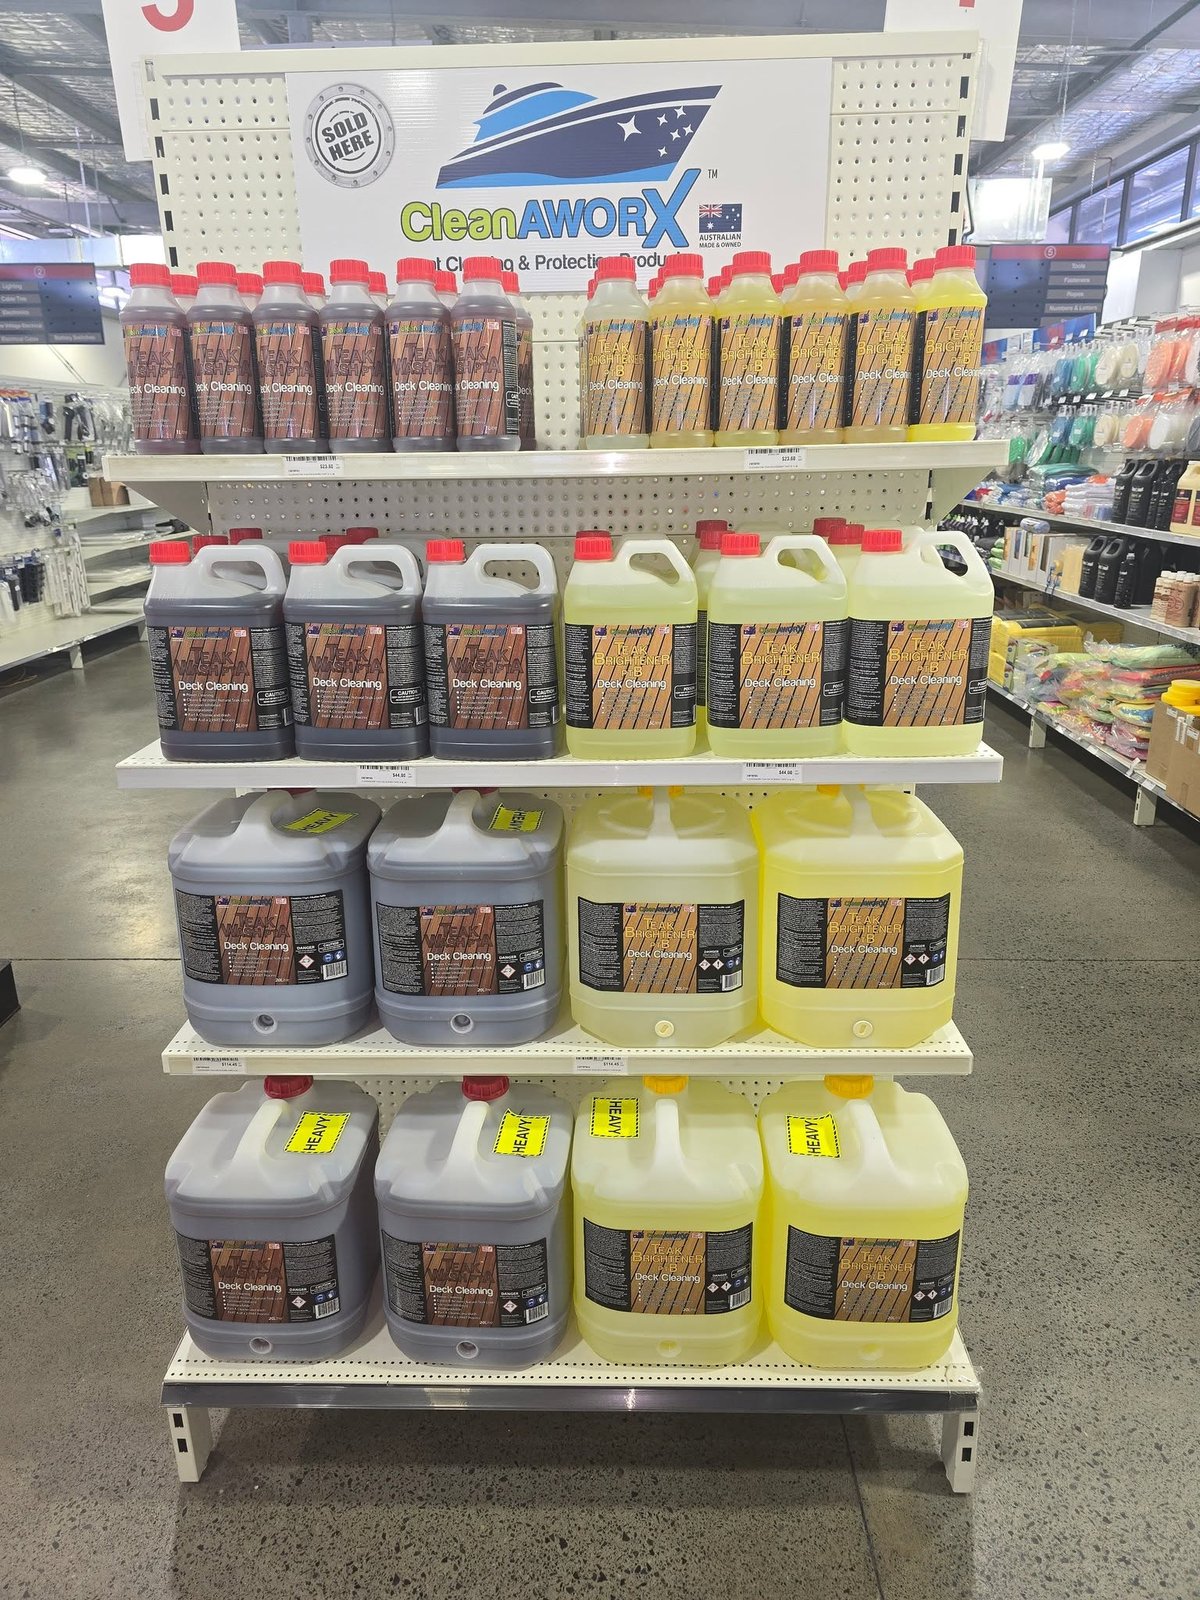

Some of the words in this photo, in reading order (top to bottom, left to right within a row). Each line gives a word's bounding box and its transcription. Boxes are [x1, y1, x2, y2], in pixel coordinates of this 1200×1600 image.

[321, 112, 369, 143] SOLD
[328, 129, 374, 161] HERE
[400, 168, 702, 248] CleanAWORX
[699, 232, 742, 241] AUSTRALIAN
[518, 254, 530, 270] &
[535, 253, 604, 270] Protecti
[1049, 304, 1073, 312] Numbers
[129, 346, 172, 366] TEAK
[198, 343, 240, 363] TEAK
[260, 344, 298, 364] TEAK
[332, 344, 374, 364] TEAK
[404, 342, 448, 362] TEAK
[791, 373, 815, 384] Deck
[858, 369, 881, 381] Deck
[926, 367, 951, 379] Deck
[394, 381, 416, 392] Deck
[461, 380, 499, 391] Cleaning
[607, 379, 643, 392] Cleaning
[671, 374, 708, 387] Cleaning
[722, 375, 742, 386] Deck
[128, 384, 142, 395] eck
[143, 383, 186, 397] Cleaning
[210, 381, 252, 395] Cleaning
[260, 385, 271, 394] eck
[271, 382, 312, 395] Cleaning
[345, 382, 384, 395] Cleaning
[614, 641, 647, 655] TEAK
[764, 640, 797, 654] TEAK
[911, 637, 946, 651] TEAK
[190, 646, 234, 665] TEAK
[325, 643, 368, 662] TEAK
[466, 643, 508, 661] TEAK
[742, 651, 820, 665] BRIGHTENER
[888, 648, 967, 662] BRIGHTENER
[594, 652, 670, 667] BRIGHTENER
[633, 666, 643, 677] B
[782, 664, 792, 676] B
[929, 661, 939, 673] B
[178, 680, 203, 691] Deck
[205, 681, 249, 693] Cleaning
[313, 677, 338, 688] Deck
[340, 678, 382, 690] Cleaning
[452, 678, 478, 688] Deck
[480, 679, 522, 690] Cleaning
[597, 679, 622, 689] Deck
[625, 679, 667, 690] Cleaning
[744, 678, 771, 688] Deck
[773, 677, 816, 688] Cleaning
[890, 675, 916, 685] Deck
[920, 675, 963, 686] Cleaning
[643, 917, 675, 930] TEAK
[848, 912, 880, 925] TEAK
[625, 926, 696, 940] BRIGHTENER
[829, 921, 902, 935] BRIGHTENER
[223, 941, 248, 951] Deck
[249, 942, 289, 953] Cleaning
[830, 944, 856, 954] Deck
[857, 944, 898, 955] Cleaning
[426, 951, 451, 961] Deck
[452, 952, 492, 962] Cleaning
[627, 949, 651, 959] Deck
[653, 950, 693, 961] Cleaning
[608, 1100, 622, 1136] HEAVY
[304, 1116, 332, 1151] HEAVY
[512, 1118, 533, 1153] HEAVY
[806, 1120, 821, 1155] HEAVY
[651, 1243, 682, 1256] TEAK
[861, 1250, 892, 1263] TEAK
[635, 1272, 659, 1282] Deck
[661, 1273, 701, 1284] Cleaning
[217, 1281, 242, 1291] Deck
[243, 1283, 282, 1294] Cleaning
[429, 1284, 453, 1294] Deck
[455, 1285, 494, 1297] Cleaning
[841, 1280, 866, 1289] Deck
[868, 1281, 908, 1292] Cleaning
